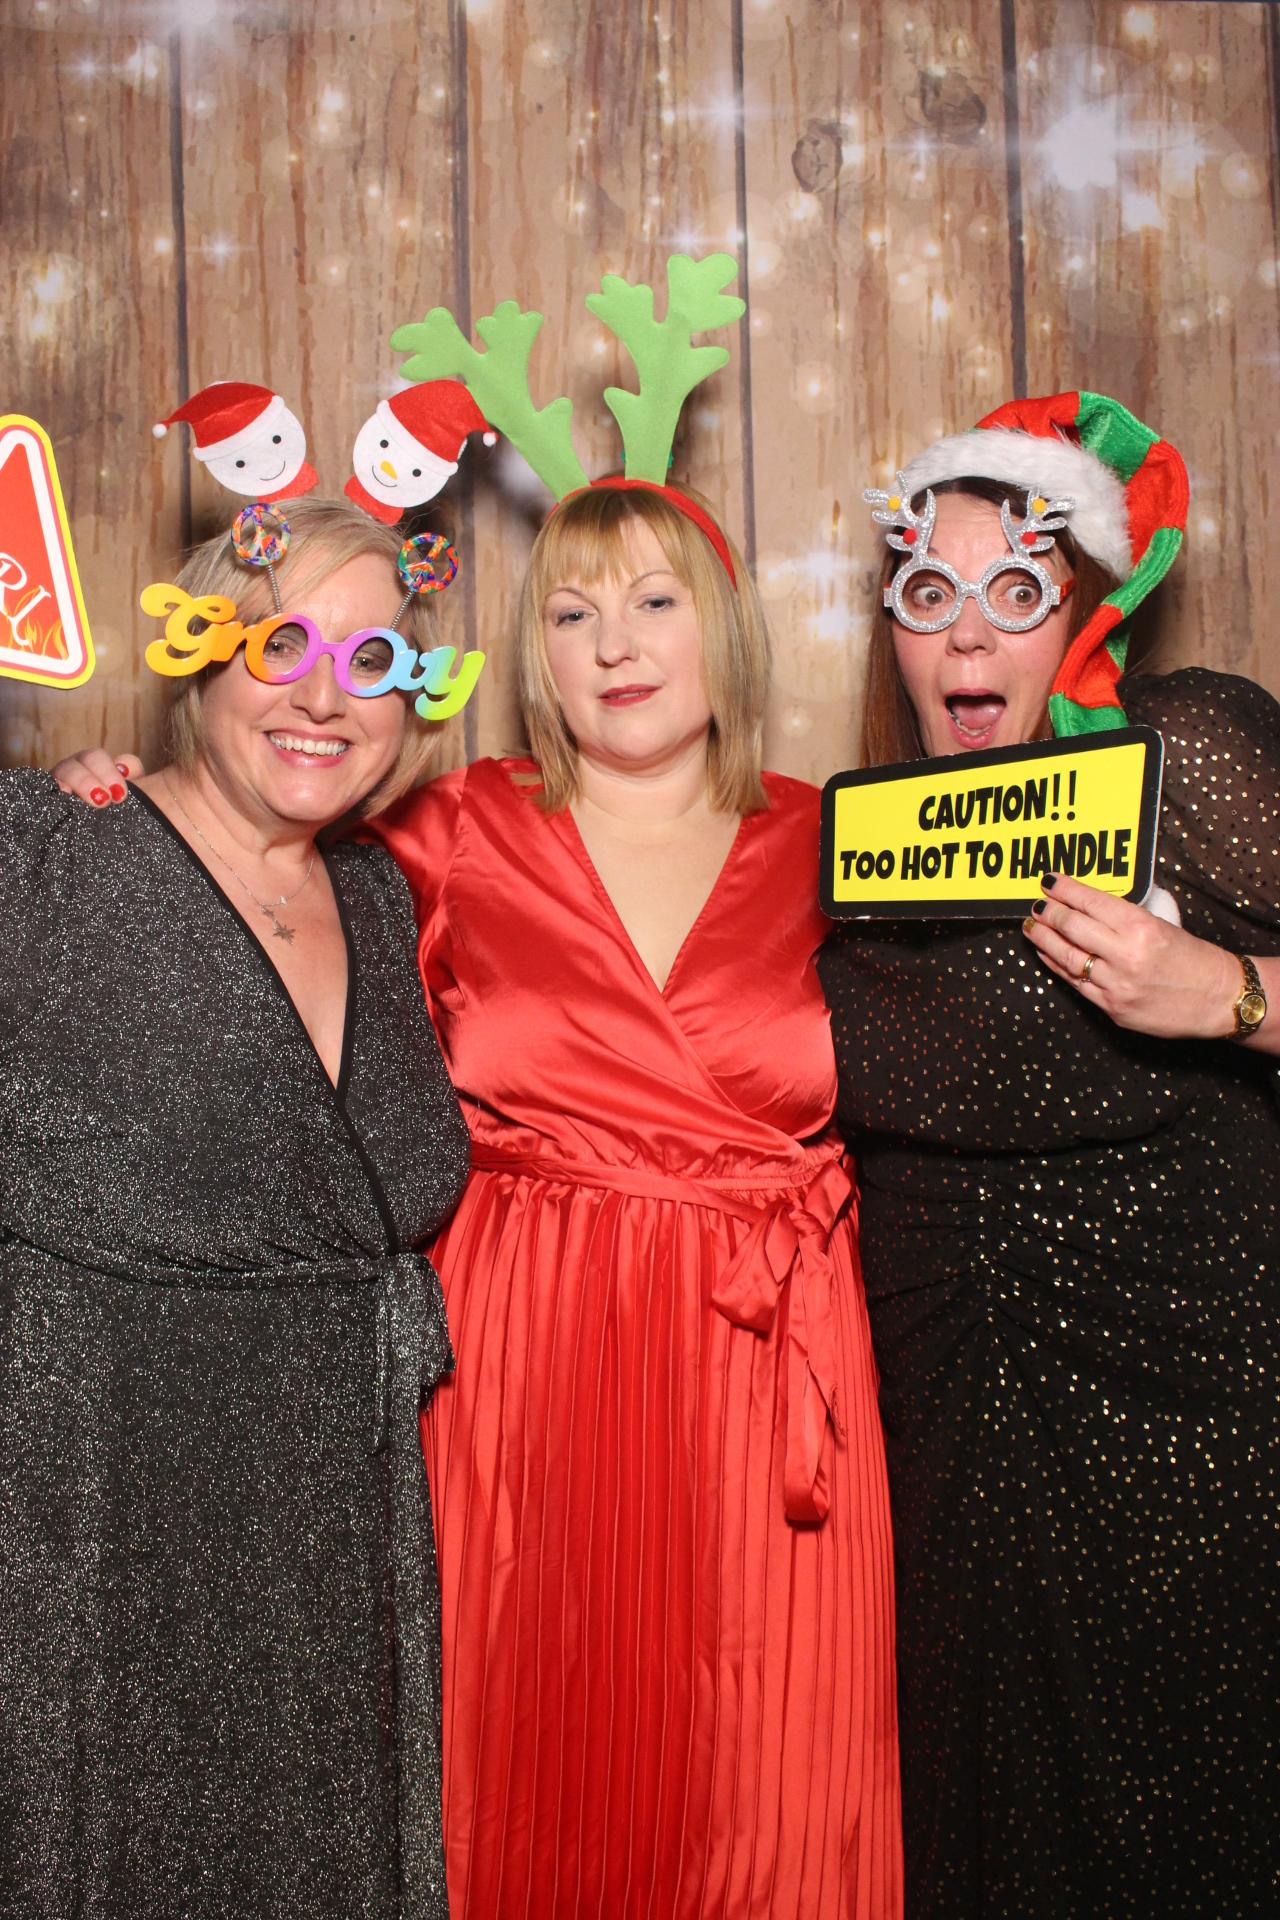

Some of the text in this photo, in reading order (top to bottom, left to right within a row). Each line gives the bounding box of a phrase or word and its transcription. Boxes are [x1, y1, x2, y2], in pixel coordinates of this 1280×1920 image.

[918, 770, 1077, 831] CAUTION!!
[840, 829, 1131, 881] TOO HOT TO HANDLE
